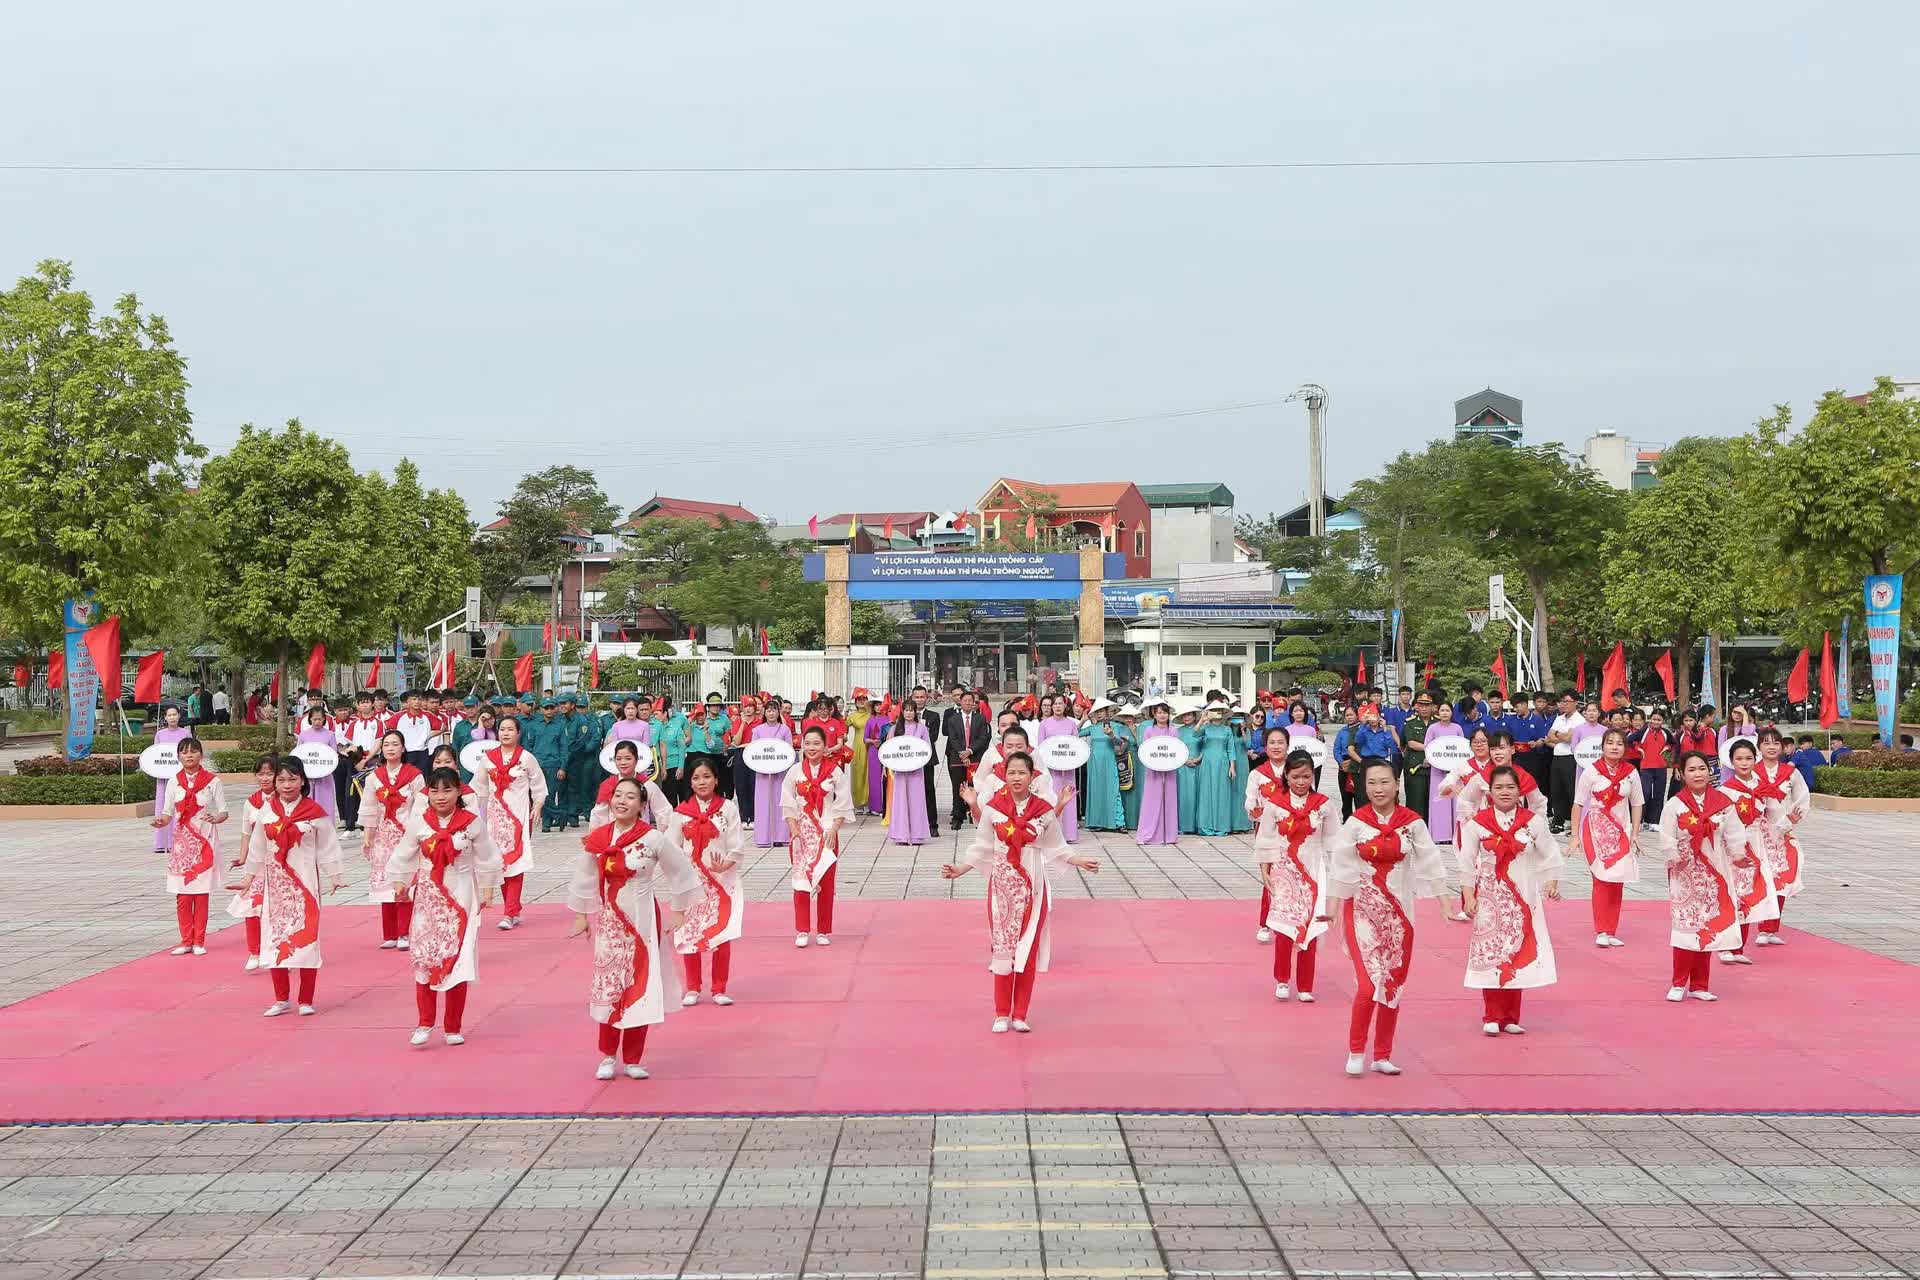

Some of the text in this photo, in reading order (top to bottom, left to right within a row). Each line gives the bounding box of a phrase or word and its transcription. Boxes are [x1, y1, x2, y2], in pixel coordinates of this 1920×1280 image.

[890, 557, 902, 565] LỢI
[904, 555, 918, 564] ÍCH
[920, 555, 941, 564] MƯỜI
[943, 556, 962, 564] NĂM
[964, 555, 976, 563] THÌ
[978, 555, 996, 563] PHẢI
[999, 553, 1026, 564] TRỒNG
[872, 566, 880, 575] VÌ
[882, 568, 894, 576] LỢI
[896, 566, 911, 575] ÍCH
[913, 567, 934, 575] TRĂM
[937, 567, 956, 575] NĂM
[958, 566, 970, 574] THÌ
[972, 566, 990, 574] PHẢI
[992, 564, 1020, 574] TRỒNG
